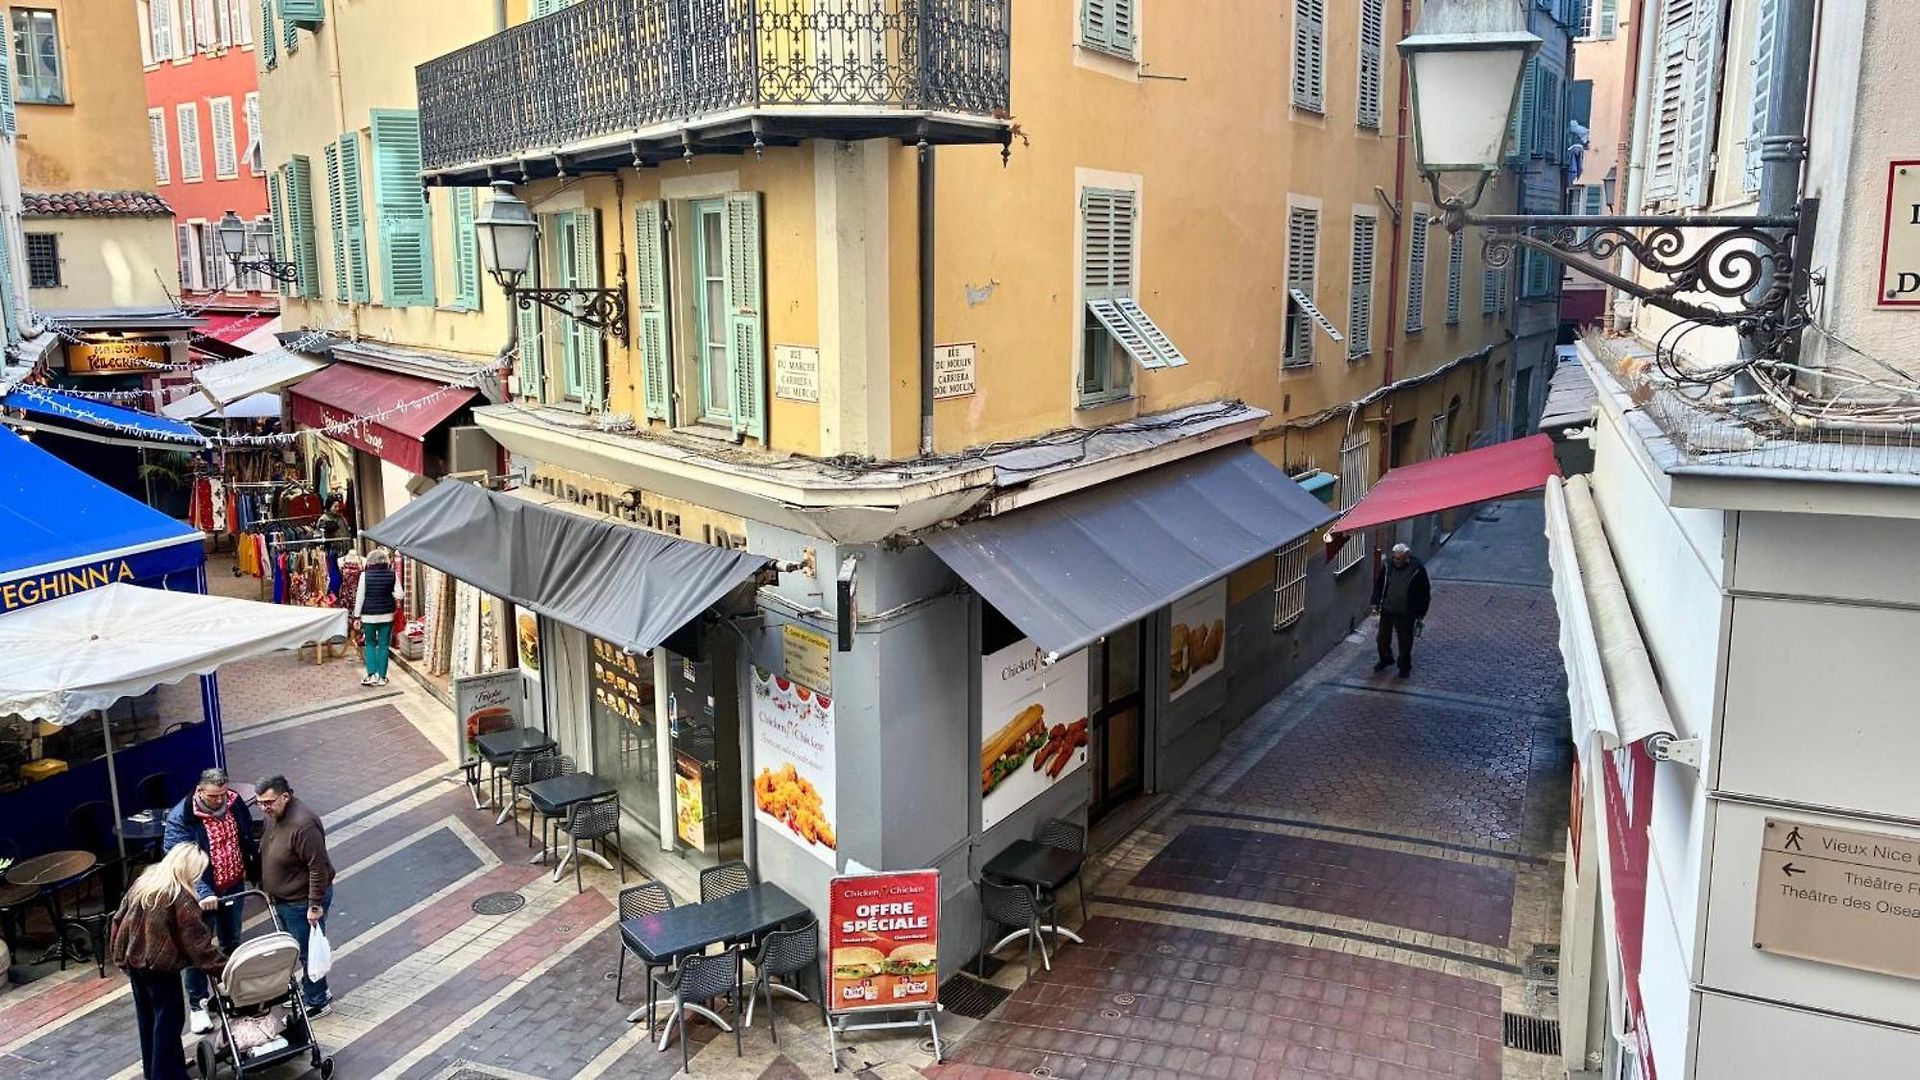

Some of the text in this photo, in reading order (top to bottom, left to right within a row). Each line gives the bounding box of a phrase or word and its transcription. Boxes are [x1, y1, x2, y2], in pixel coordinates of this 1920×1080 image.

[948, 349, 960, 357] RUE
[935, 358, 970, 369] DU MOULIN
[938, 373, 969, 384] CARRIERA
[949, 383, 974, 393] MOULIN
[0, 560, 135, 609] EGHINN'A
[1822, 837, 1868, 856] Vieux
[1873, 845, 1912, 862] Nice
[1845, 872, 1920, 896] Théâtre F
[844, 886, 924, 898] Chicken Chicken
[1781, 883, 1838, 904] Théâtre
[1842, 896, 1871, 911] des
[856, 902, 914, 917] OFFRE
[842, 916, 928, 934] SPÉCIALE
